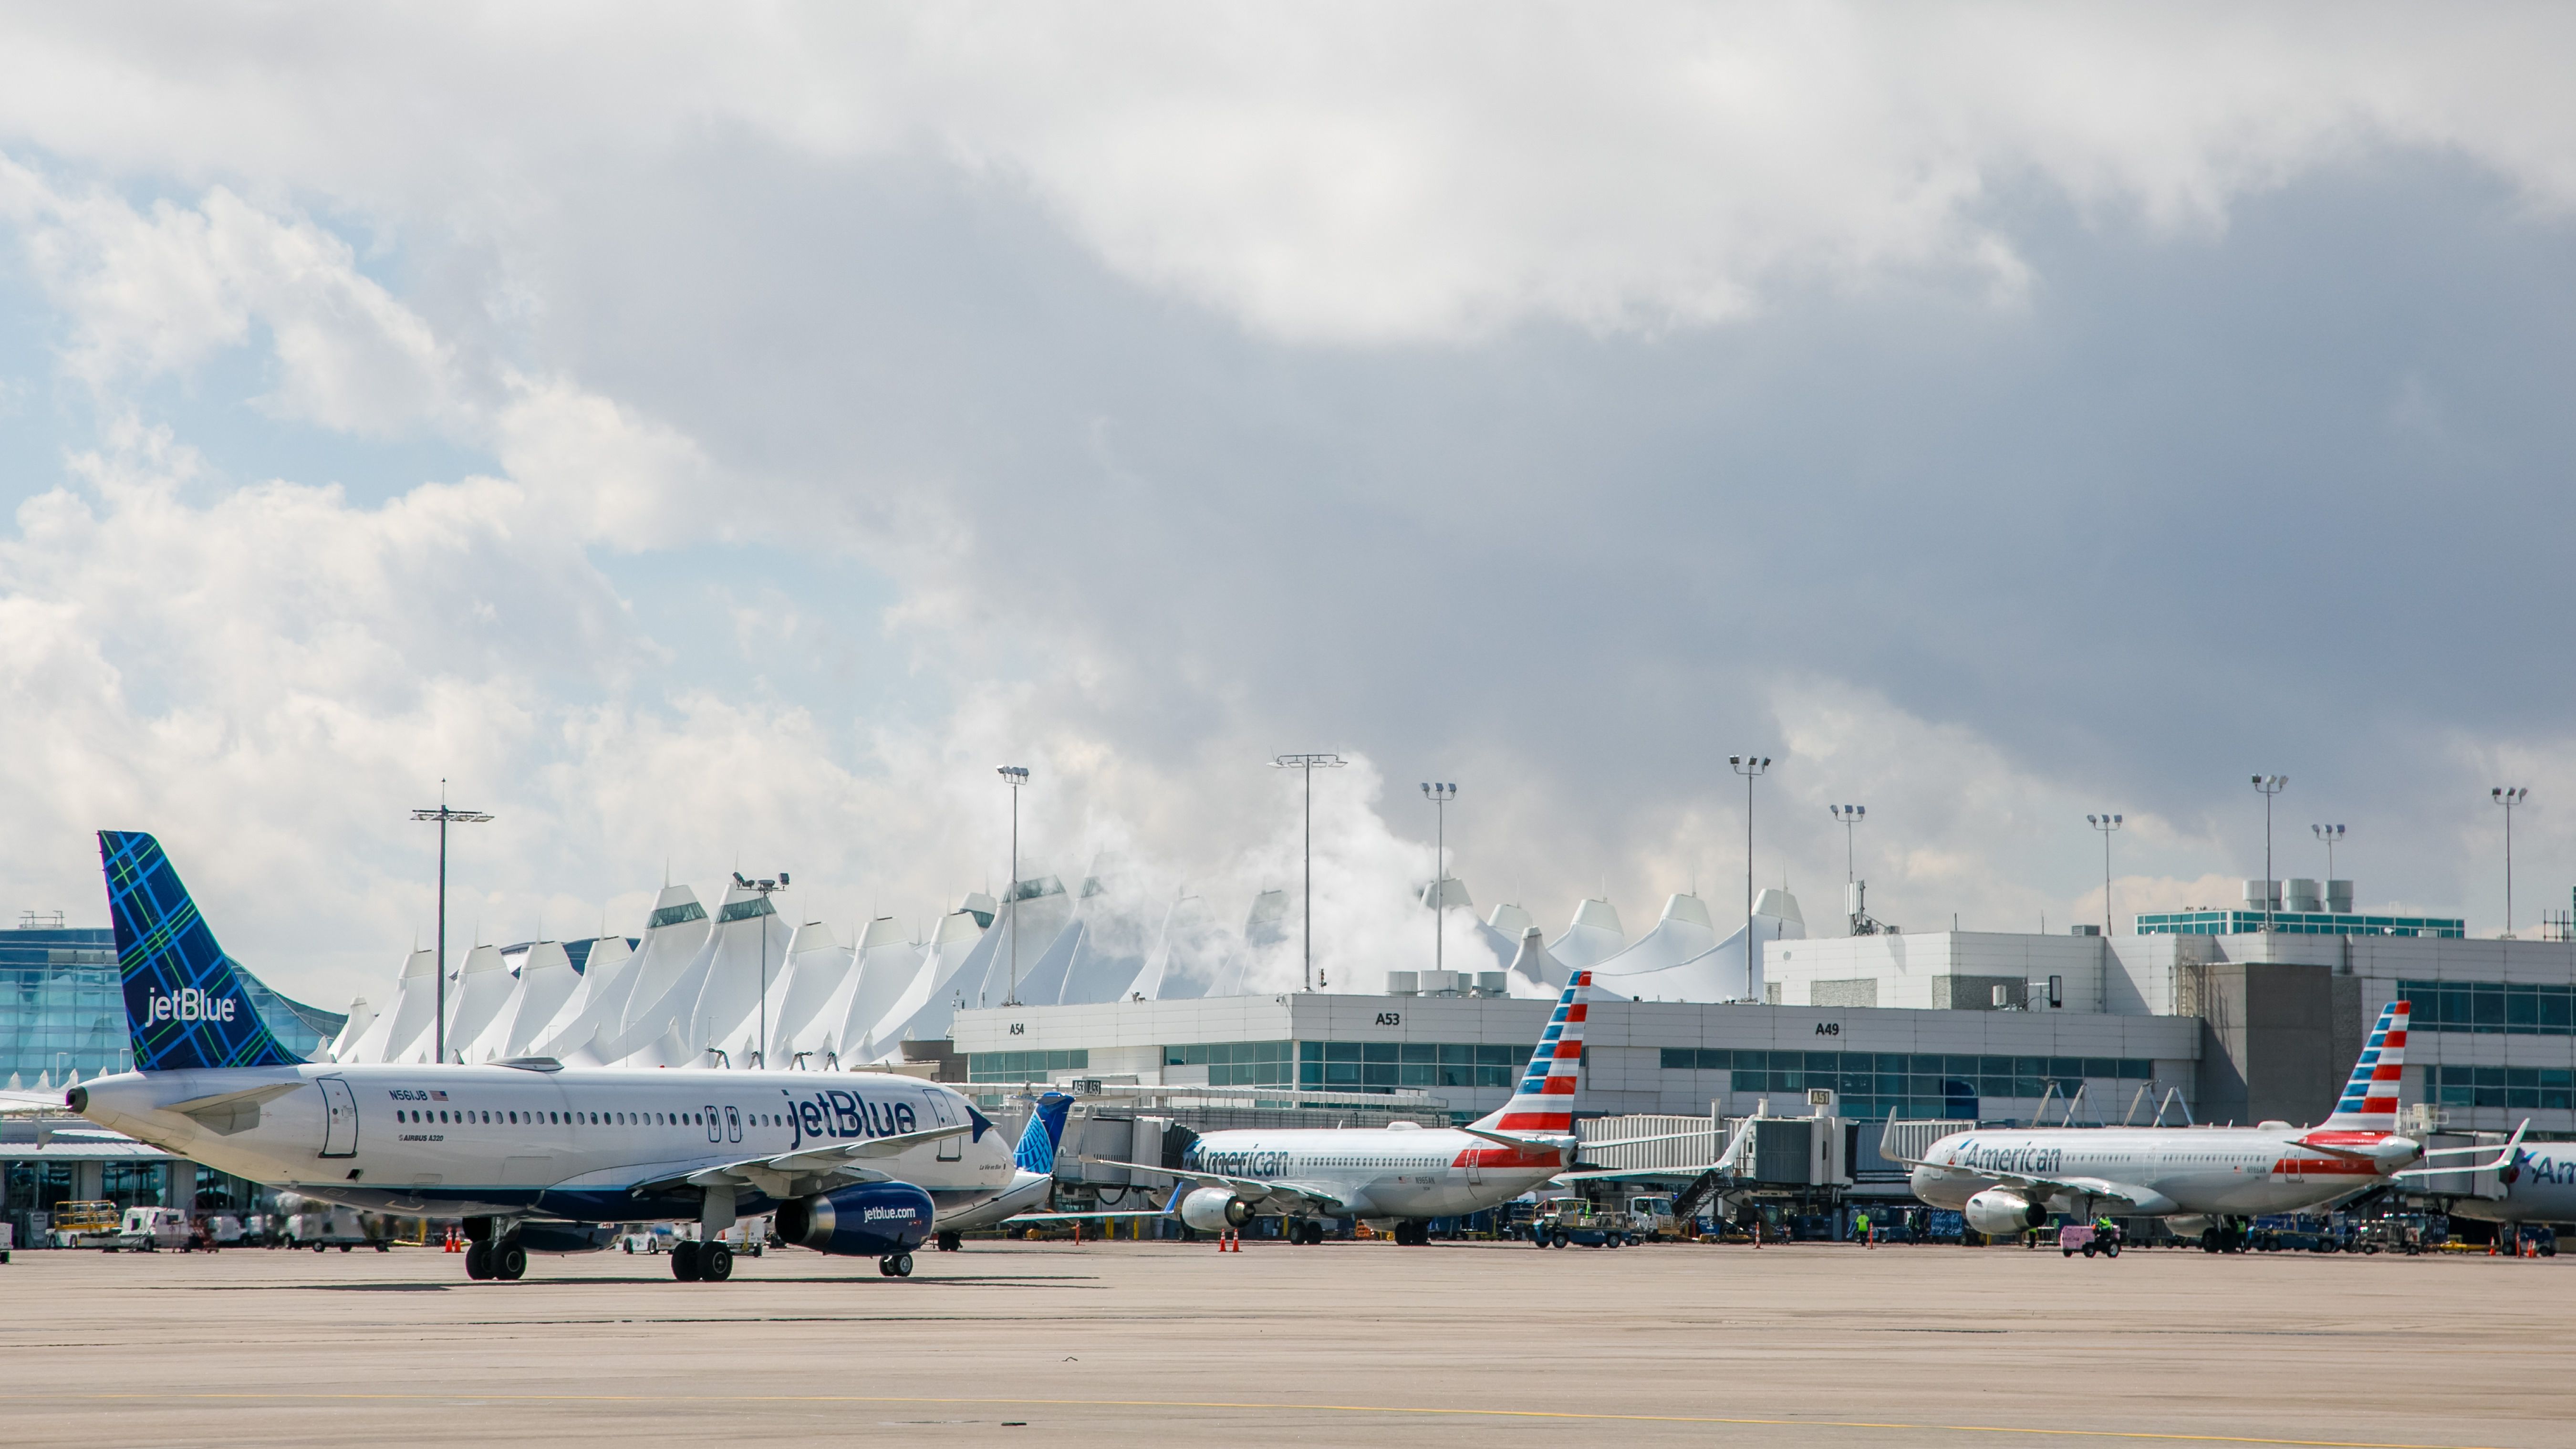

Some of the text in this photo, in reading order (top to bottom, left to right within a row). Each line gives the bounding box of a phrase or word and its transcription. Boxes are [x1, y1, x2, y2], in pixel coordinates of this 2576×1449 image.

[145, 987, 235, 1027] jetBlue
[1375, 1013, 1400, 1025] A53
[1010, 1023, 1024, 1035] A54
[1815, 1023, 1839, 1035] A49
[1074, 1081, 1085, 1094] A53
[1089, 1082, 1100, 1095] A53
[389, 1090, 428, 1101] N561JB
[1813, 1092, 1828, 1103] A51
[781, 1086, 916, 1150] jetBlue
[1192, 1144, 1288, 1177] American
[1964, 1141, 2061, 1172] American
[864, 1206, 915, 1223] jetblue.com
